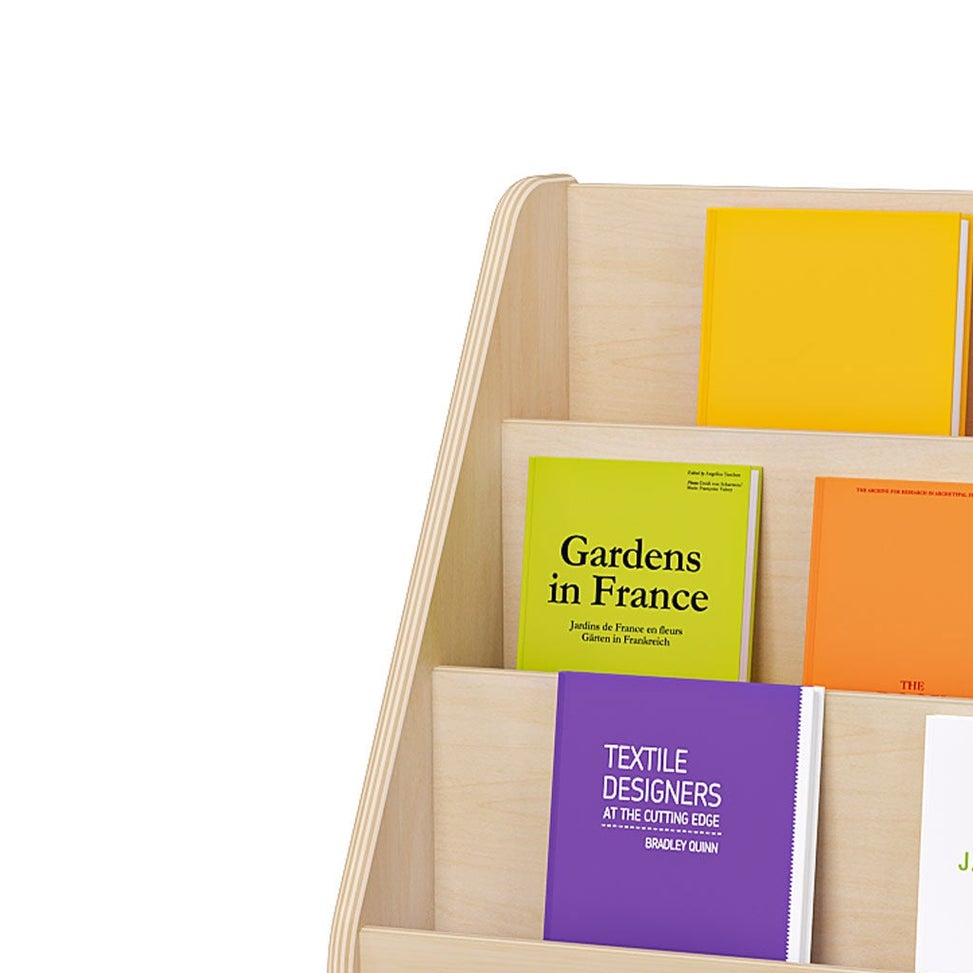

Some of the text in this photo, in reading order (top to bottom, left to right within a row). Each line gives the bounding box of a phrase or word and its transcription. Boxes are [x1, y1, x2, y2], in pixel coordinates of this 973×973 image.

[560, 534, 702, 572] Gardens
[547, 572, 709, 612] in France
[568, 620, 683, 635] Jardins de France en fleurs
[581, 632, 670, 647] Gärten in Frankreich
[900, 679, 925, 692] THE
[604, 744, 688, 774] TEXTILE
[602, 775, 722, 808] DESIGNERS
[603, 806, 720, 828] AT THE CUTTING EDGE
[645, 837, 719, 854] BRADLEY QUINN
